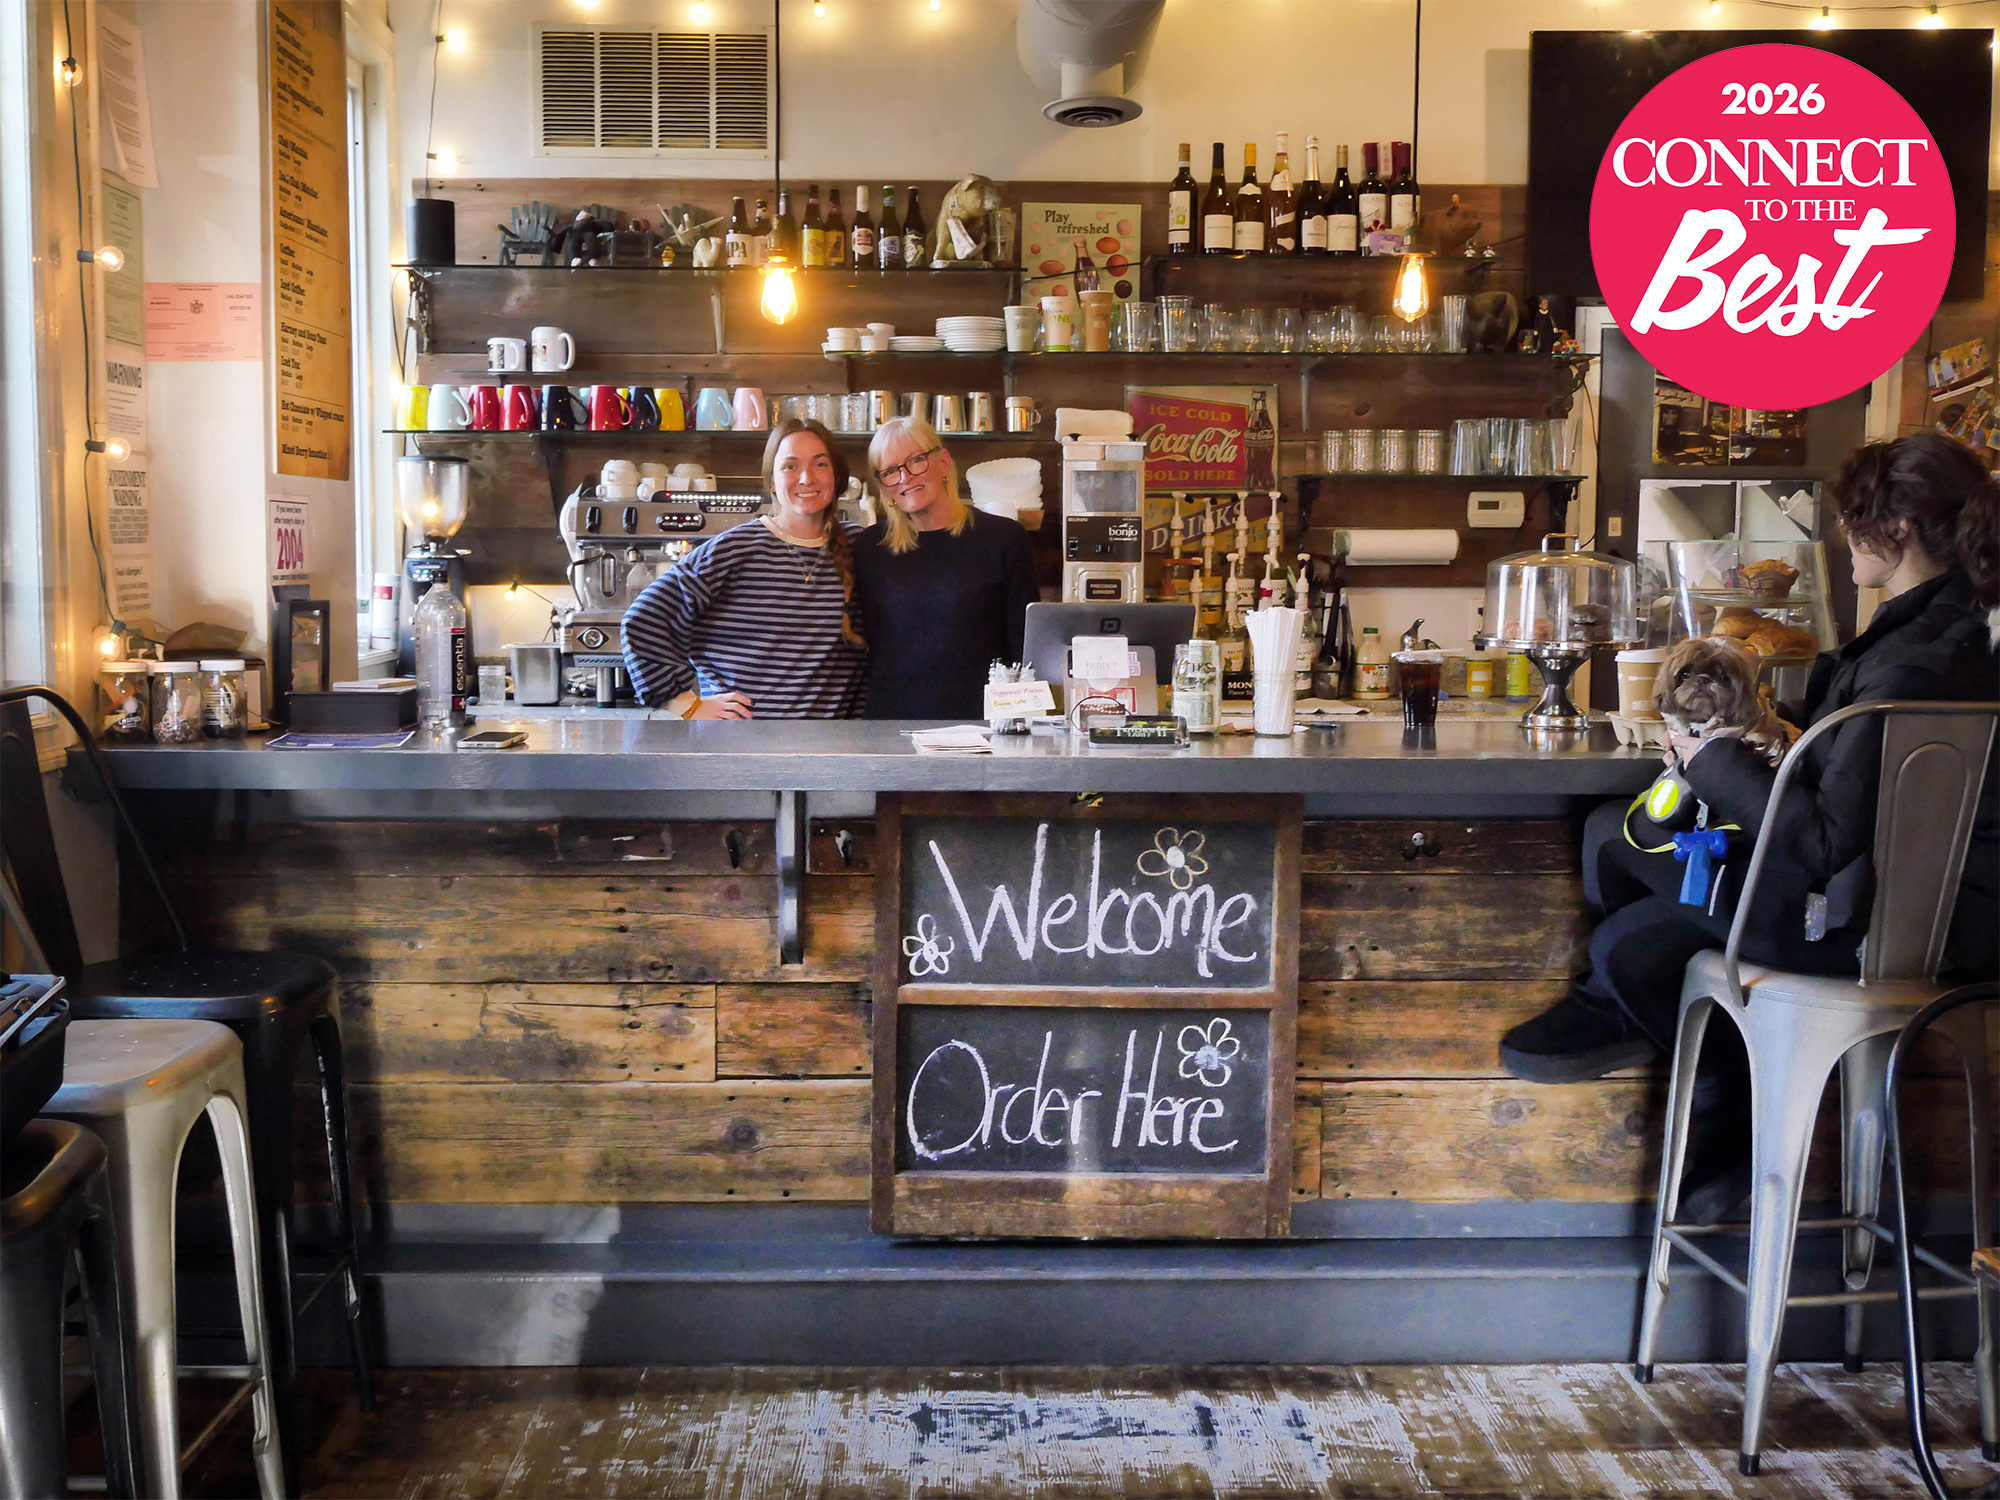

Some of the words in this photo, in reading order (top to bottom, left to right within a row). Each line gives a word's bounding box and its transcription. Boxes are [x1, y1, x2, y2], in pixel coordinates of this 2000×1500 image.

[1045, 210, 1070, 225] Play
[1057, 223, 1110, 234] refreshed
[726, 241, 747, 258] IPA
[106, 361, 142, 388] WARNING
[1150, 403, 1179, 418] ICE
[1186, 408, 1232, 422] COLD
[1145, 470, 1189, 481] SOLD
[1194, 470, 1236, 481] HERE
[1109, 527, 1138, 537] bonjo
[277, 528, 304, 570] 2004
[455, 637, 464, 691] essentia
[929, 823, 1257, 979] Welcome
[906, 1030, 1102, 1162] Order
[1112, 1029, 1239, 1154] Here
